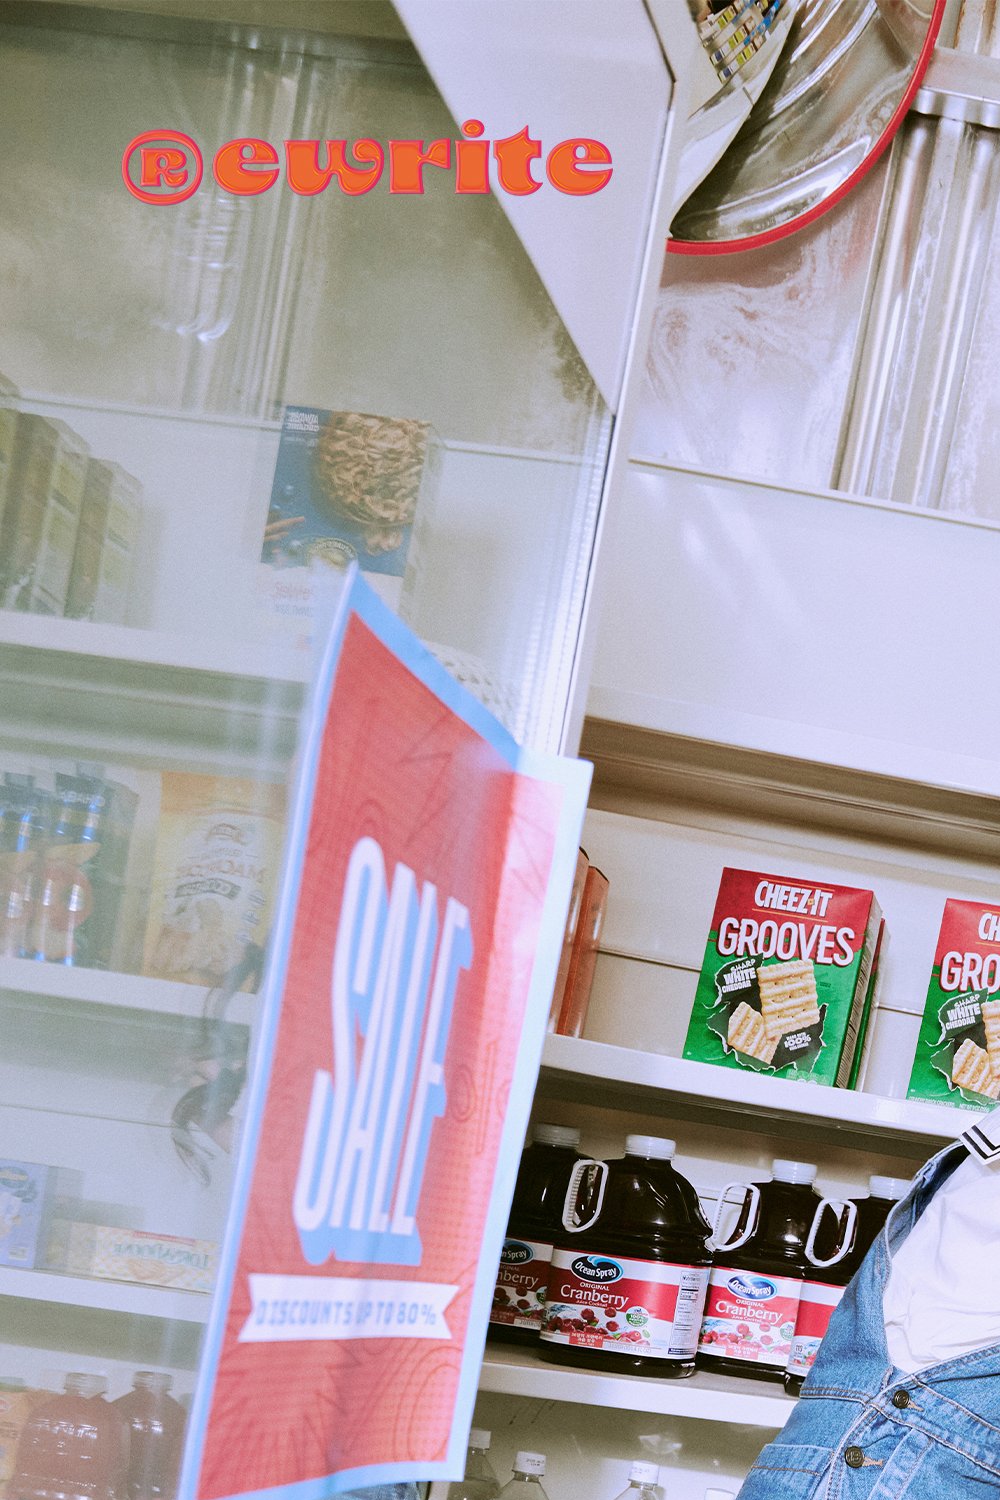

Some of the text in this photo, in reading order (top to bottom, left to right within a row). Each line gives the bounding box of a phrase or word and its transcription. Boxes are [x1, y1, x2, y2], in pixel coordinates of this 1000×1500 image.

[717, 917, 856, 967] GROOVES
[730, 959, 756, 973] SHARP
[724, 967, 757, 985] WHITE
[722, 981, 752, 994] CHEDDAR
[954, 993, 981, 1008] SHARP
[947, 1002, 981, 1022] WHITE
[945, 1015, 976, 1031] CHEDDAR
[293, 836, 472, 1250] SALE
[507, 1249, 527, 1261] Spray
[574, 1261, 617, 1280] Ocean Spray
[498, 1270, 539, 1290] nberry
[580, 1281, 610, 1292] ORIGINAL
[731, 1280, 772, 1297] Ocean Spray
[560, 1284, 629, 1310] Cranberry
[715, 1300, 783, 1325] Cranberry
